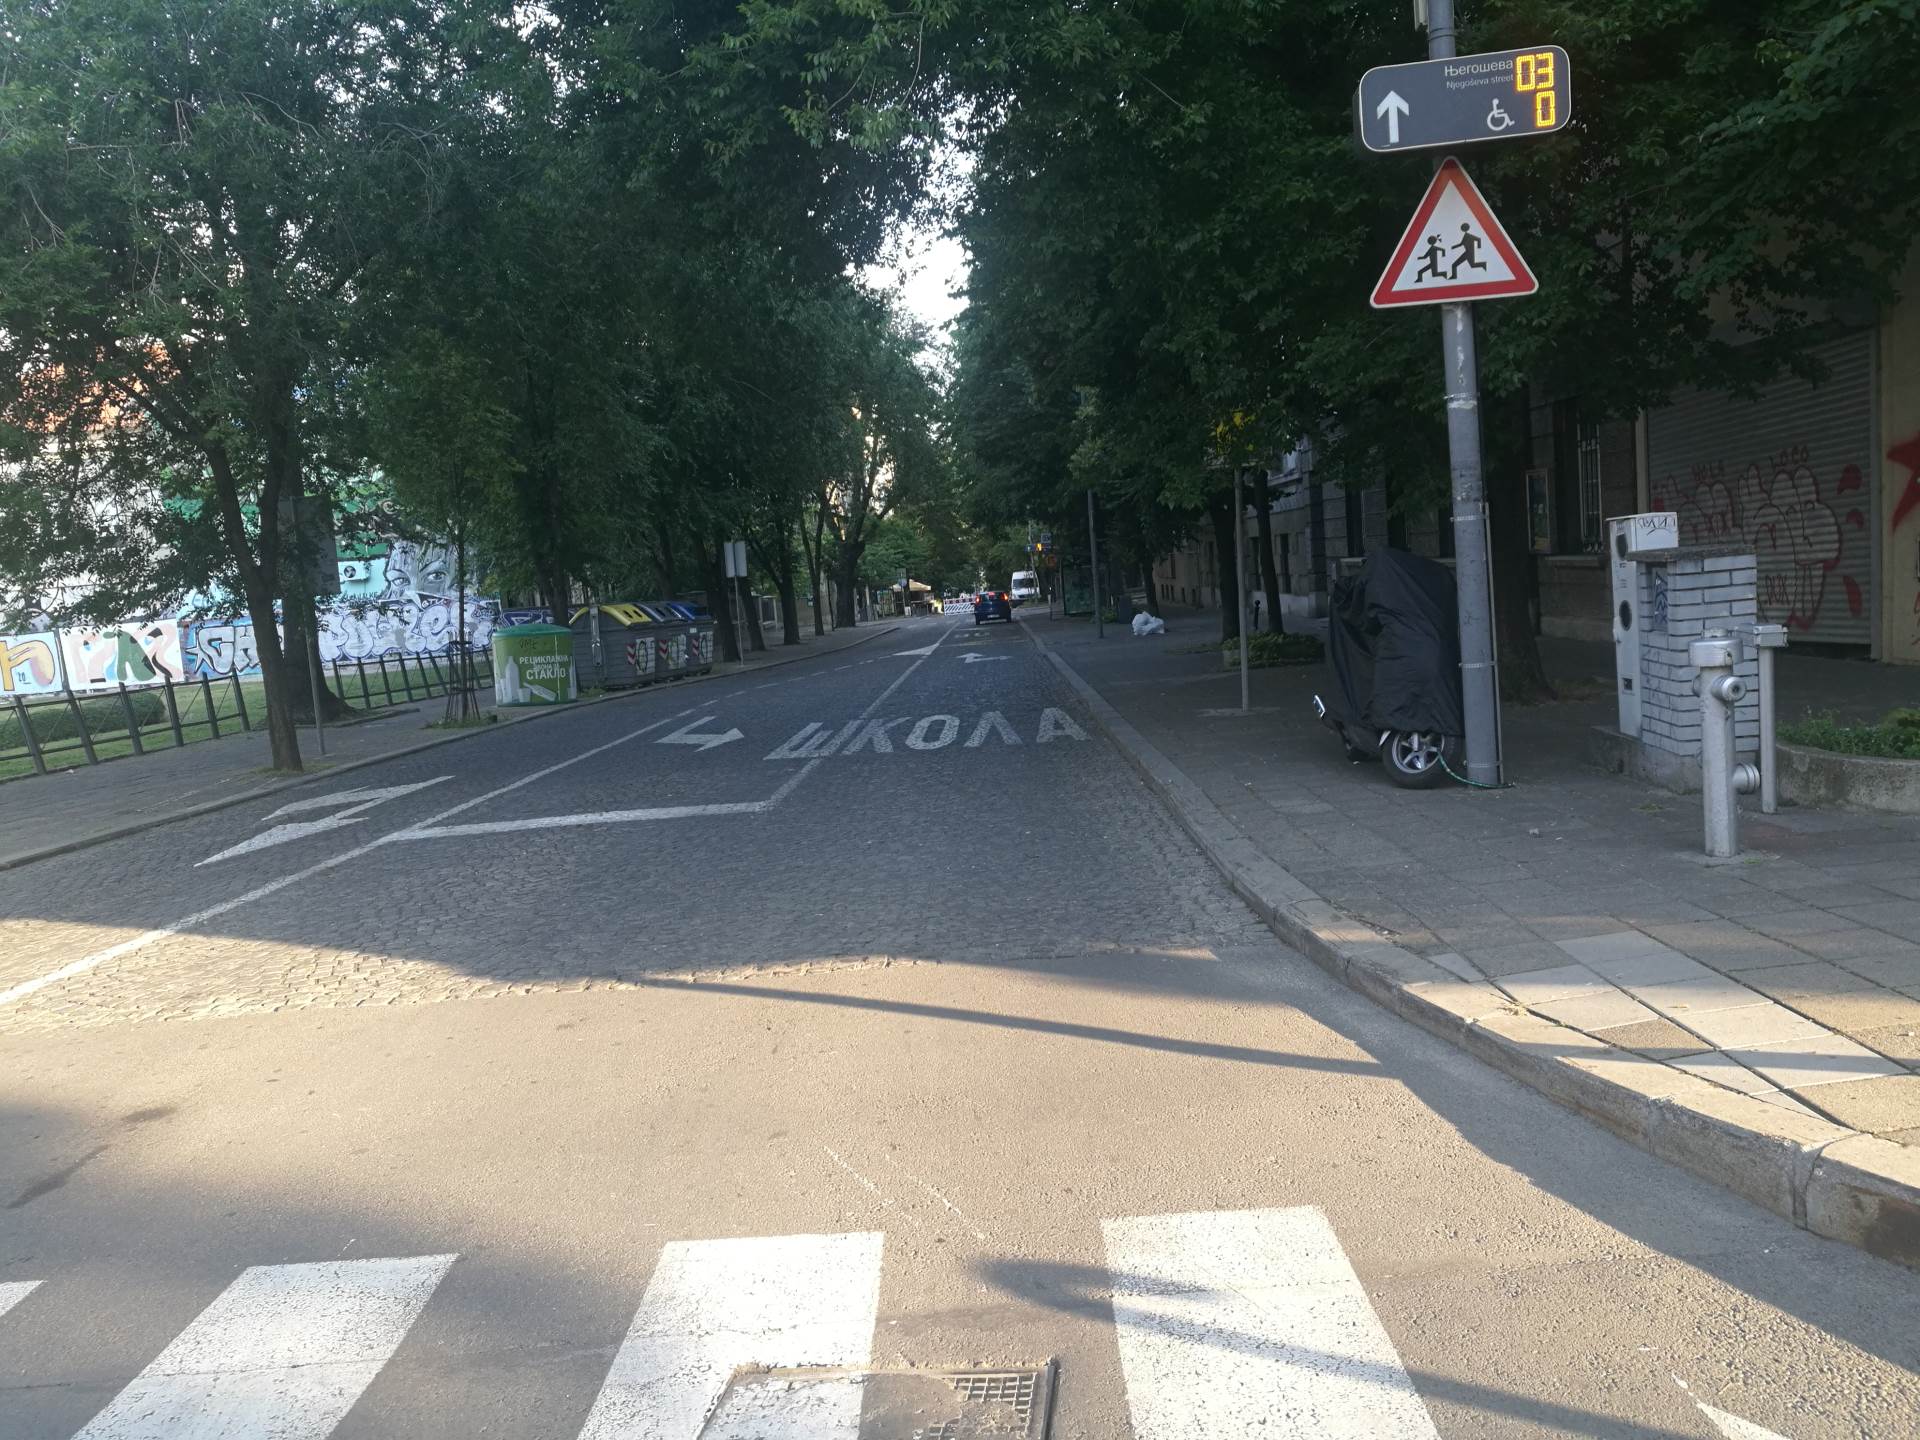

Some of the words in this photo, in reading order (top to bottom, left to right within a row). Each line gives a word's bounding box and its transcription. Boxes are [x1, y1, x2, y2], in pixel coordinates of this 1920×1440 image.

[1444, 59, 1513, 77] Његошева
[1490, 73, 1514, 84] street
[1515, 51, 1555, 92] 03
[1535, 90, 1556, 127] 0
[526, 667, 567, 680] СТАКЛО
[762, 707, 1092, 761] ШКОЛА
